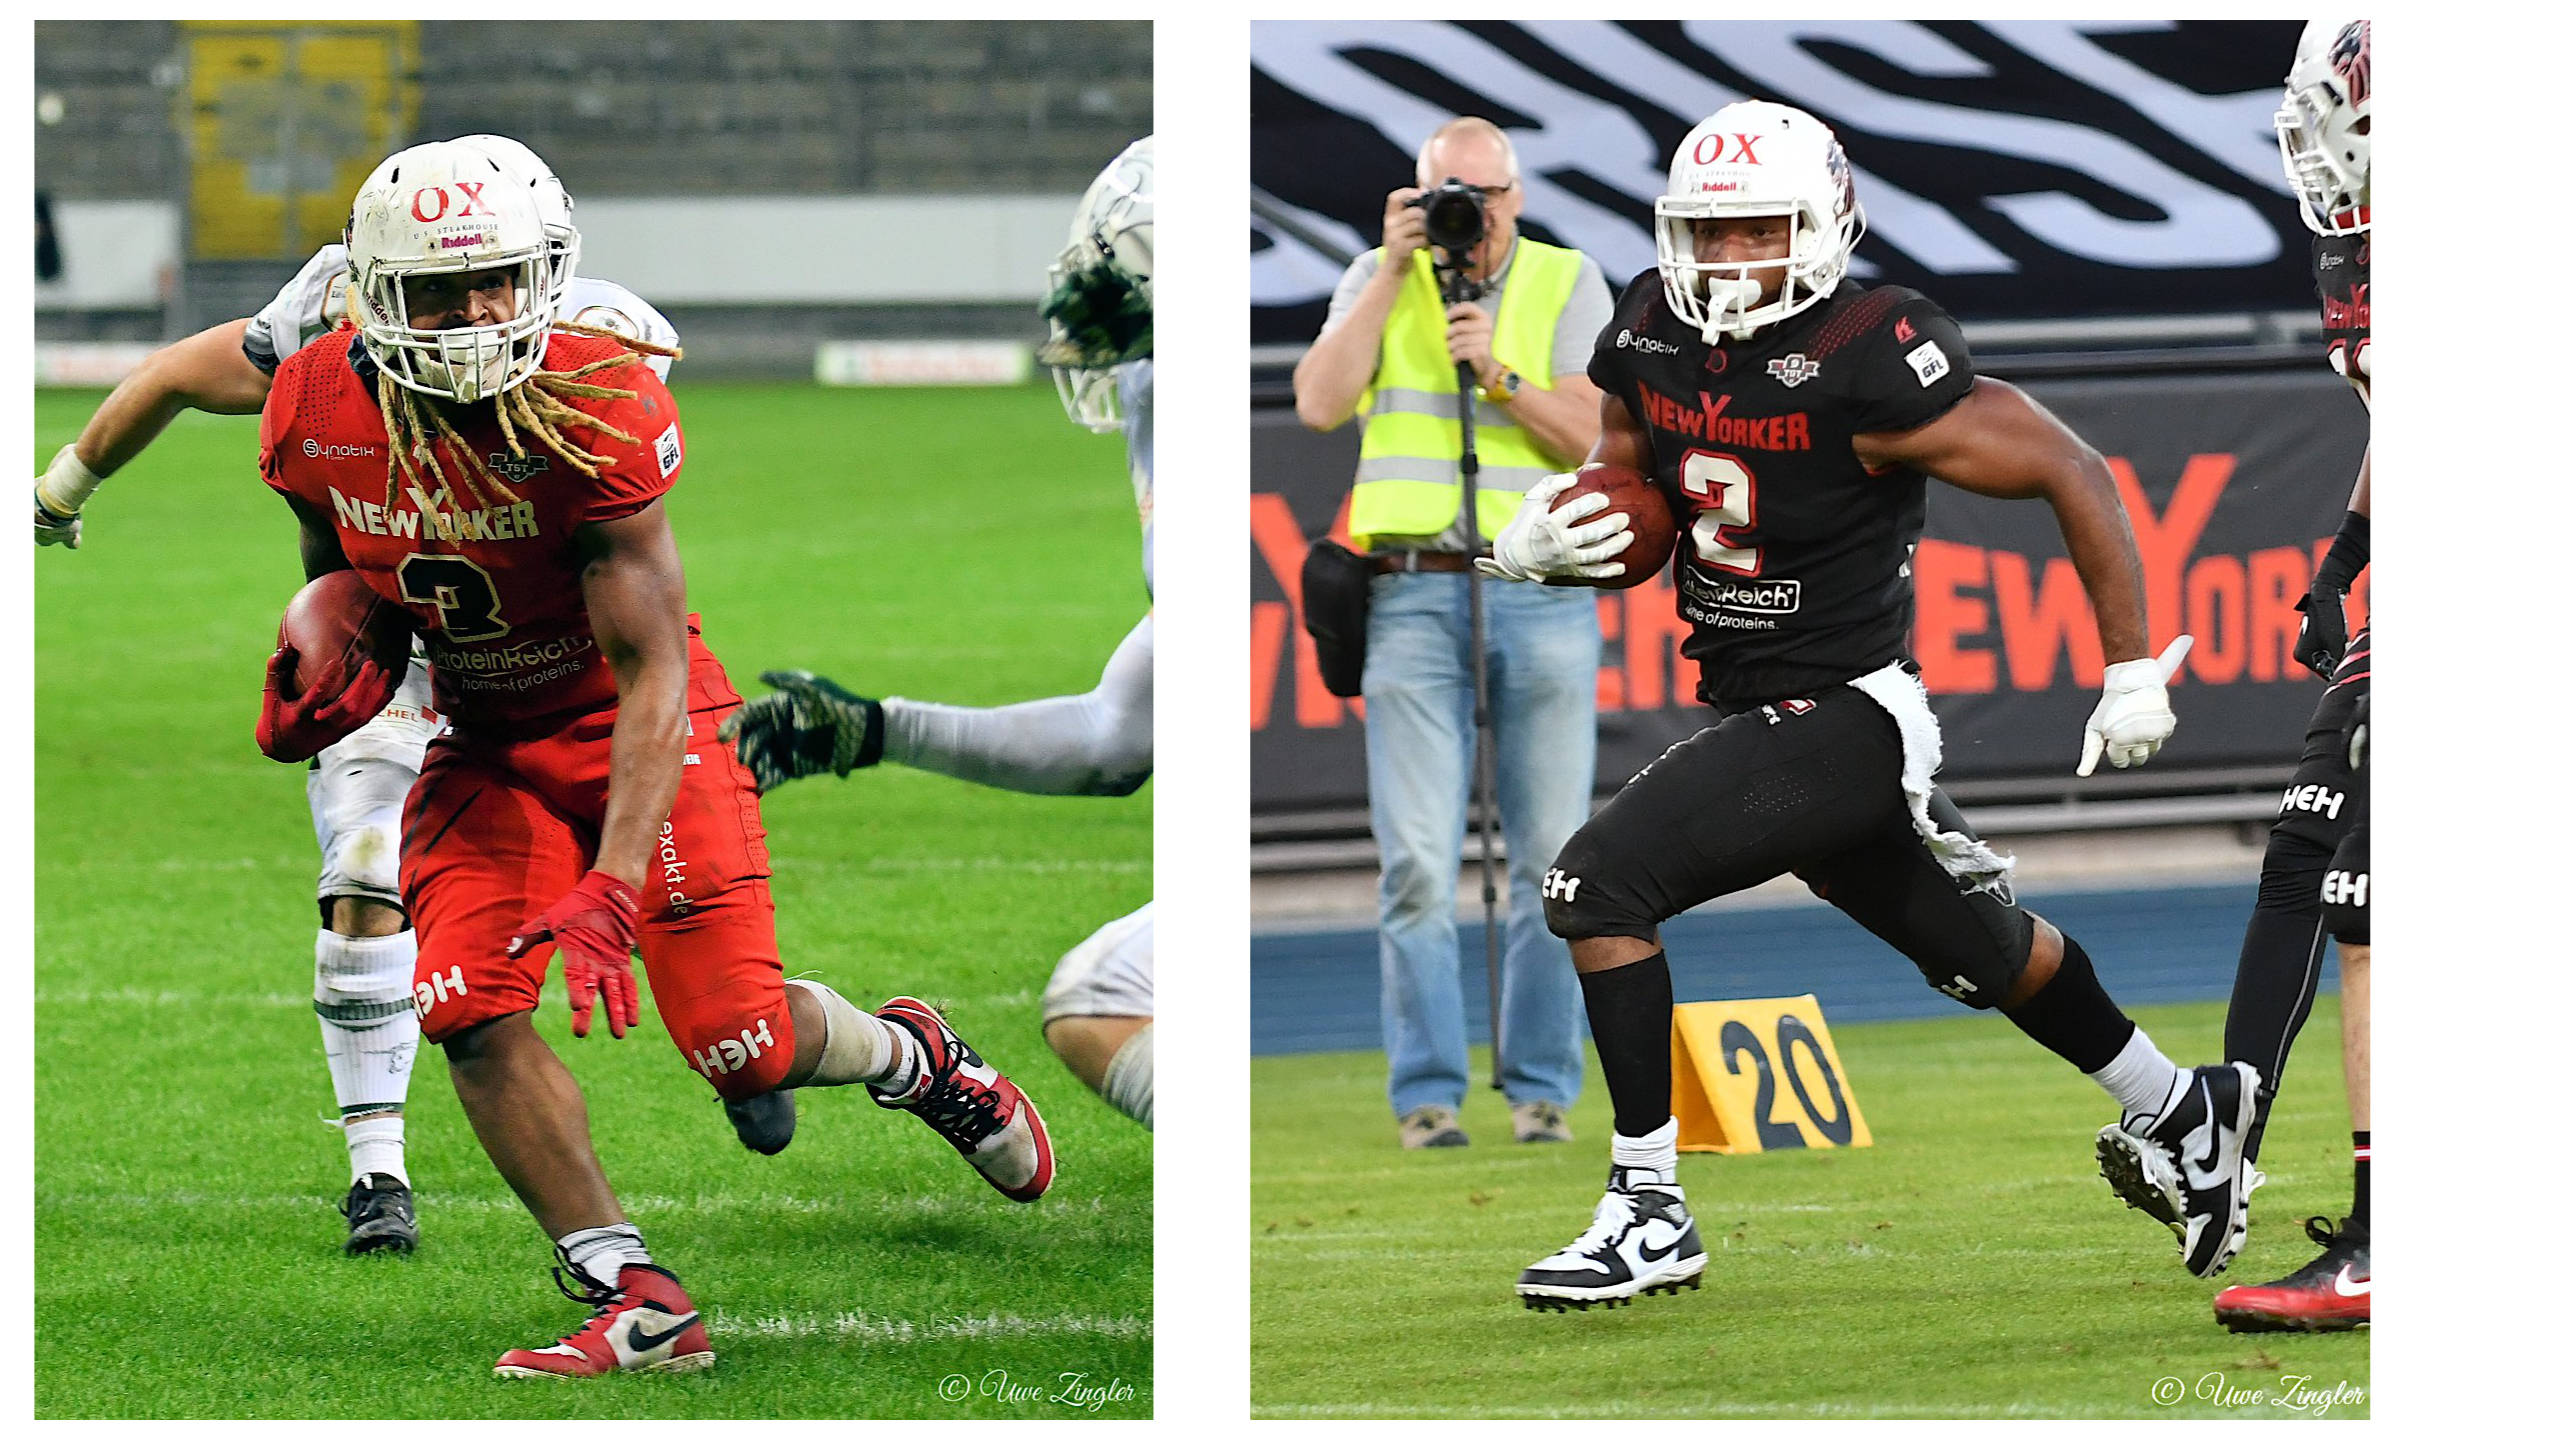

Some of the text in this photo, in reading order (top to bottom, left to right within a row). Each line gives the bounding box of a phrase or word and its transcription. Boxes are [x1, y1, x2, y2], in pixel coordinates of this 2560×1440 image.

[1693, 133, 1765, 166] OX
[411, 182, 497, 223] OX
[1702, 181, 1737, 192] Riddell
[441, 233, 483, 249] Riddell
[1922, 359, 1944, 378] GFL
[303, 438, 375, 460] Synatix
[663, 446, 679, 470] GFL
[506, 463, 529, 473] TST
[1679, 446, 1765, 578] 2
[377, 708, 419, 723] HEL
[2279, 784, 2345, 820] HEH
[659, 810, 694, 914] exakt.de
[1542, 867, 1581, 902] EH
[2323, 869, 2369, 908] EH
[1720, 1014, 1853, 1151] 20
